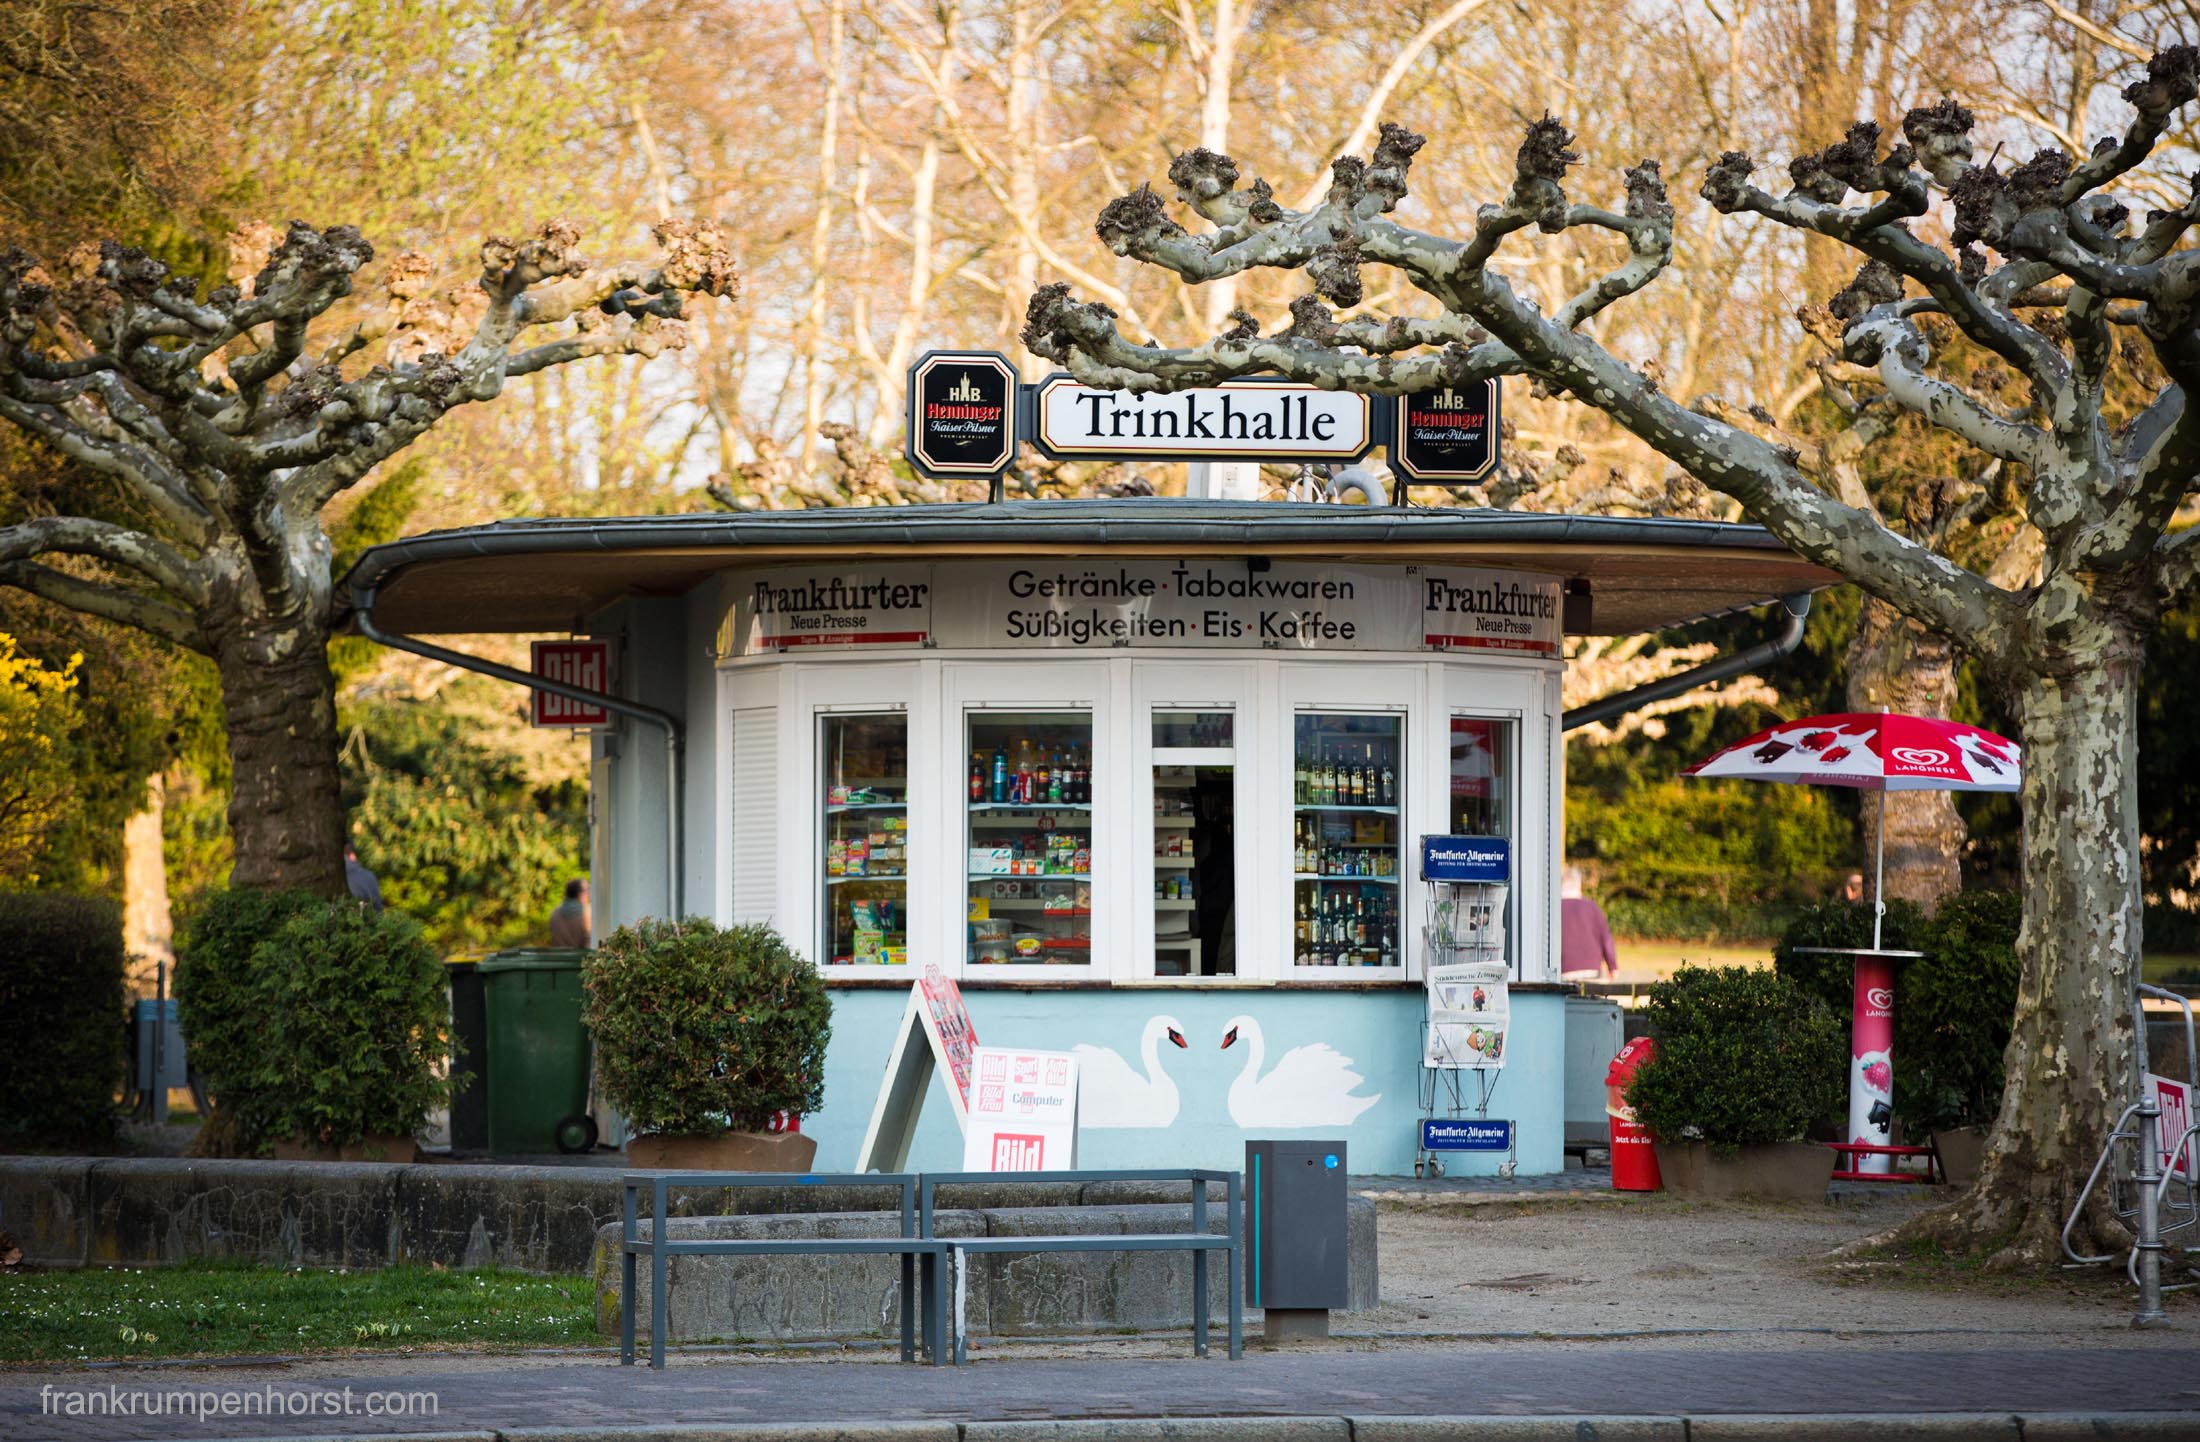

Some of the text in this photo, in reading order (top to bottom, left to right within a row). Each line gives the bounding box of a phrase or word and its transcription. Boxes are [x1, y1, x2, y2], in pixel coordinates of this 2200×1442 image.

[927, 403, 1002, 422] Henninger
[1076, 392, 1336, 441] Trinkhalle
[1410, 411, 1485, 430] Henninger
[754, 577, 928, 614] Frankfurter
[1008, 569, 1355, 600] Getränke Tabakwaren
[1425, 578, 1557, 619] Frankfurter
[790, 613, 867, 630] Neue Presse
[1006, 609, 1356, 644] Süßigkeiten Eis Kaffee
[1476, 616, 1532, 634] Neue Presse
[544, 652, 600, 716] Bild
[1895, 764, 1956, 774] LANGNESE
[1430, 849, 1504, 862] Frankfurter Allgemeine
[1013, 1093, 1064, 1106] Computer
[1429, 1126, 1504, 1138] Frankfurter Allgemeine
[2160, 1092, 2186, 1160] Bild
[996, 1138, 1041, 1172] Bild
